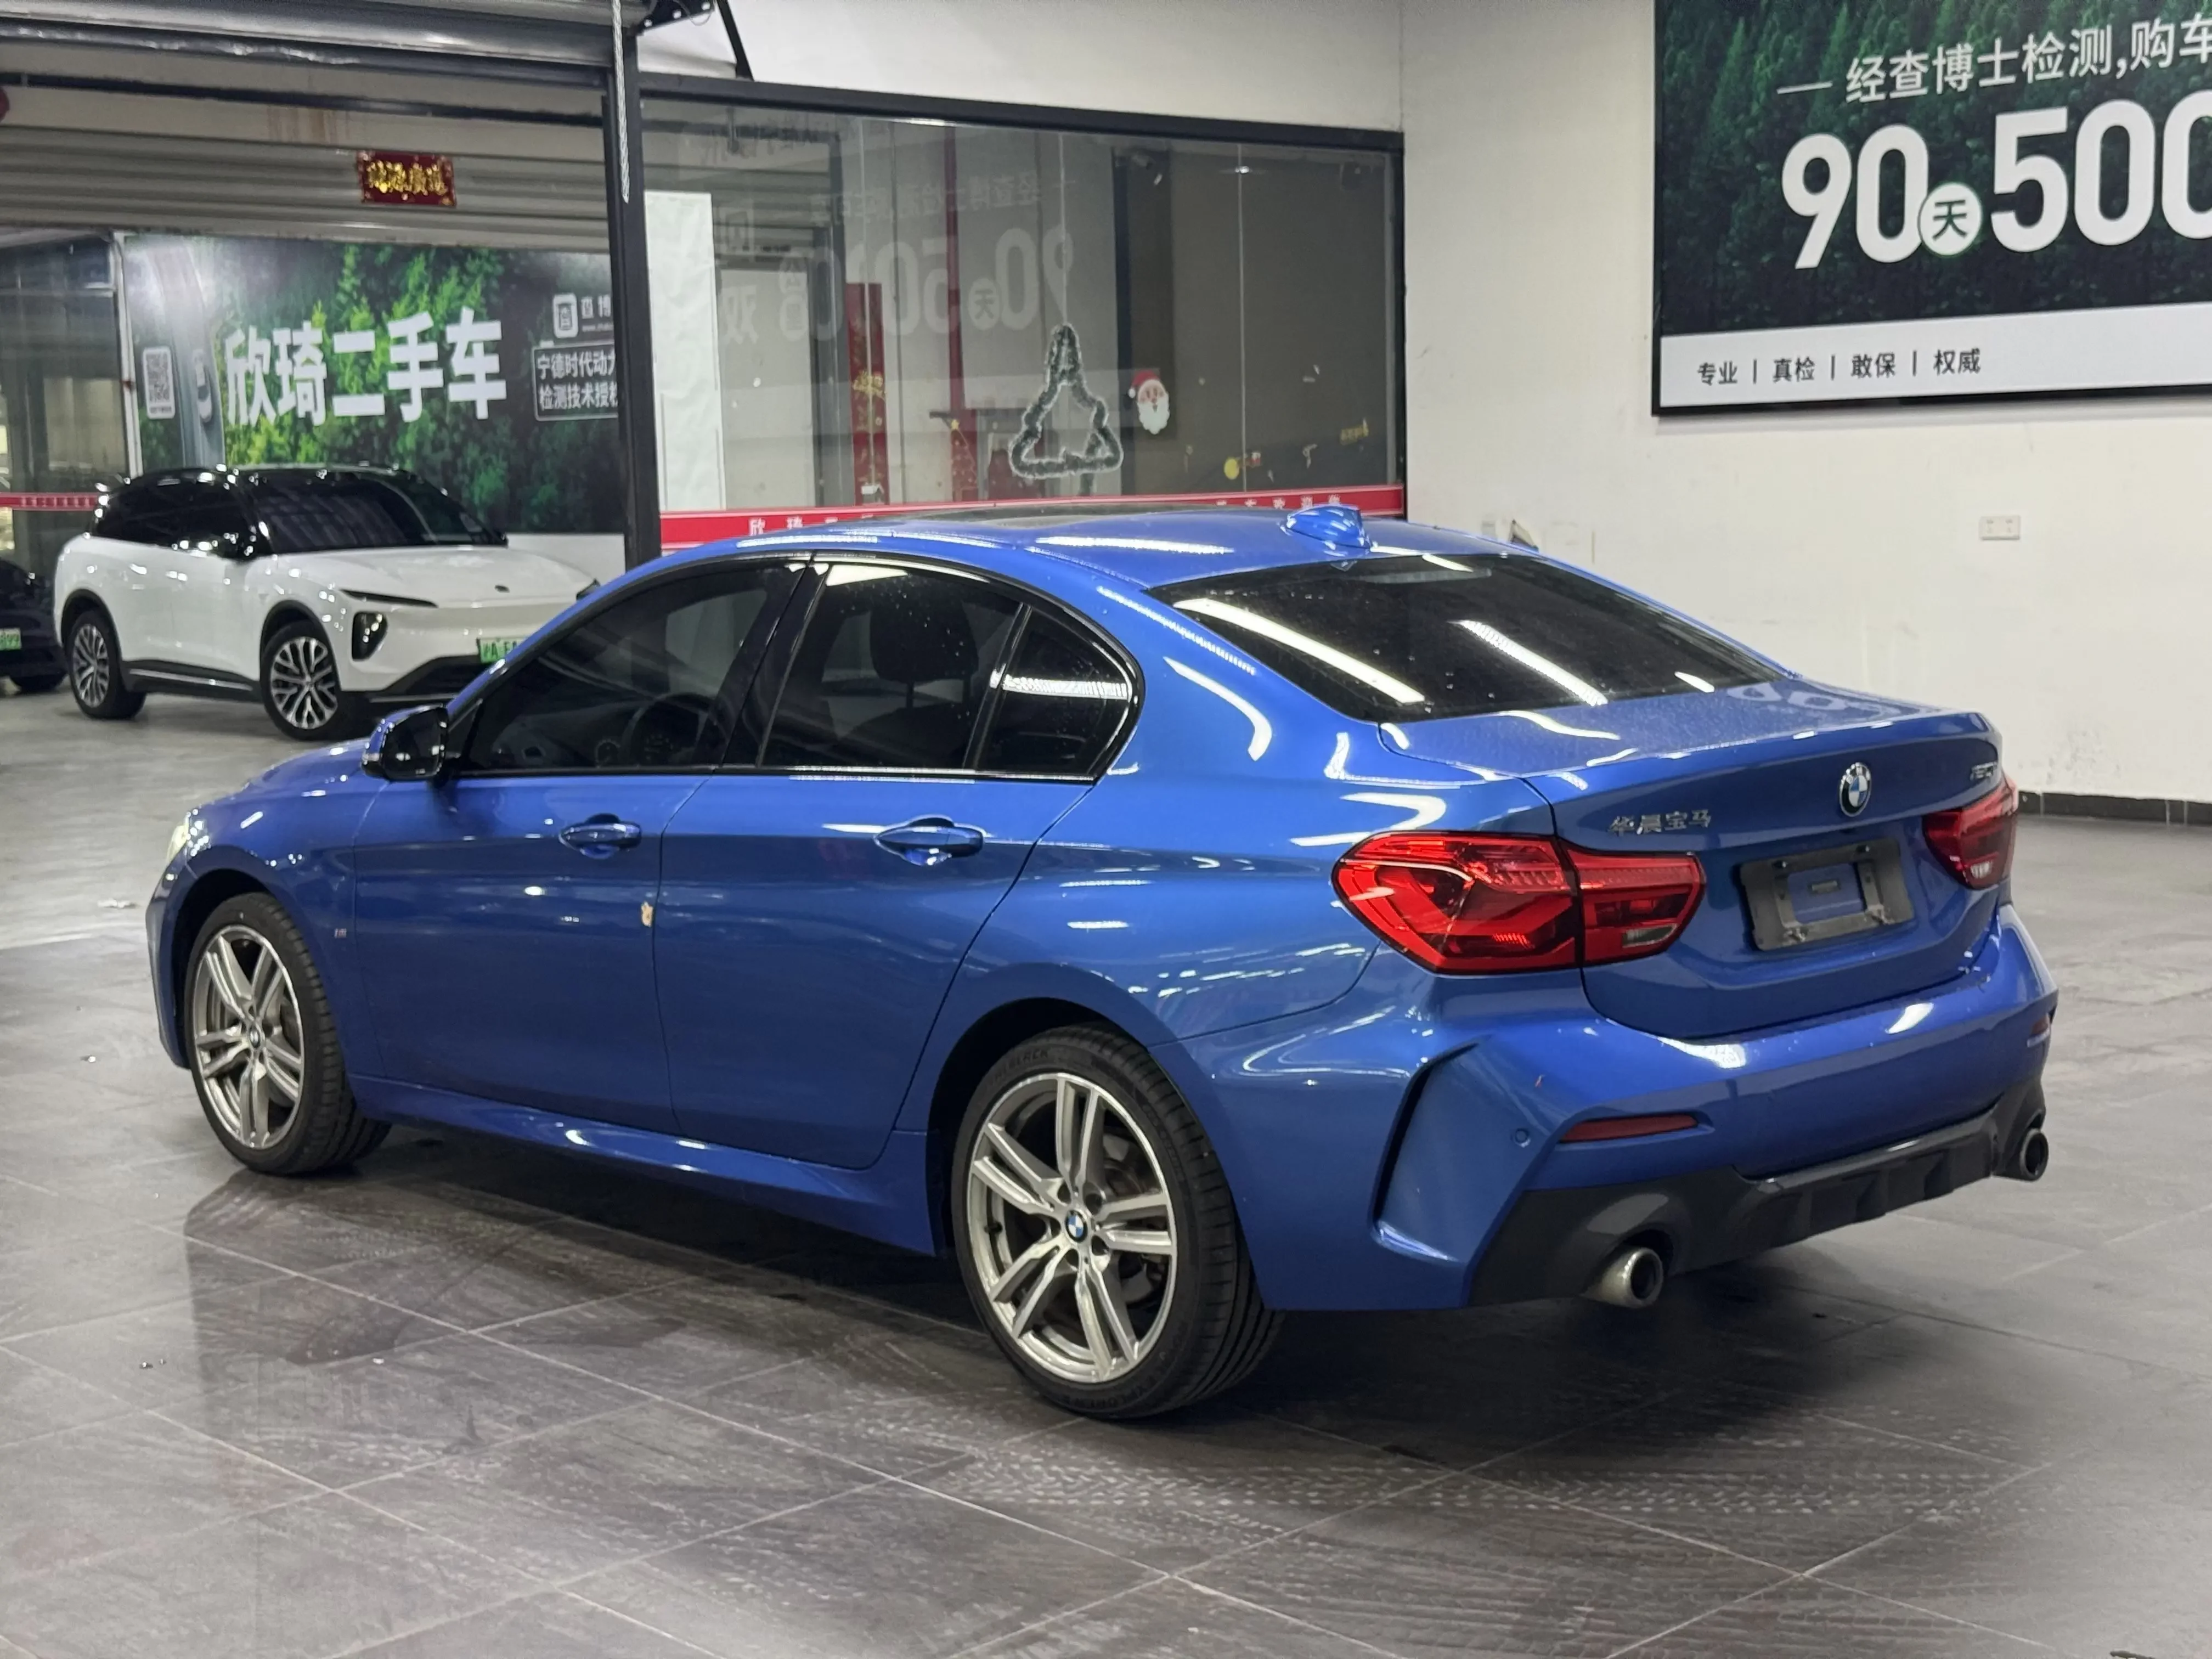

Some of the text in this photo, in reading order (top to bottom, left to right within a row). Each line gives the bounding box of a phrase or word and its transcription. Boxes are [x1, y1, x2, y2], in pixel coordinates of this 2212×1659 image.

[1847, 13, 2212, 104] 经查博士检测,购车
[224, 306, 507, 427] 欣琦二手车
[1697, 347, 1982, 386] 专业 真检 敢保 权威
[1607, 809, 1712, 837] 华晨宝马
